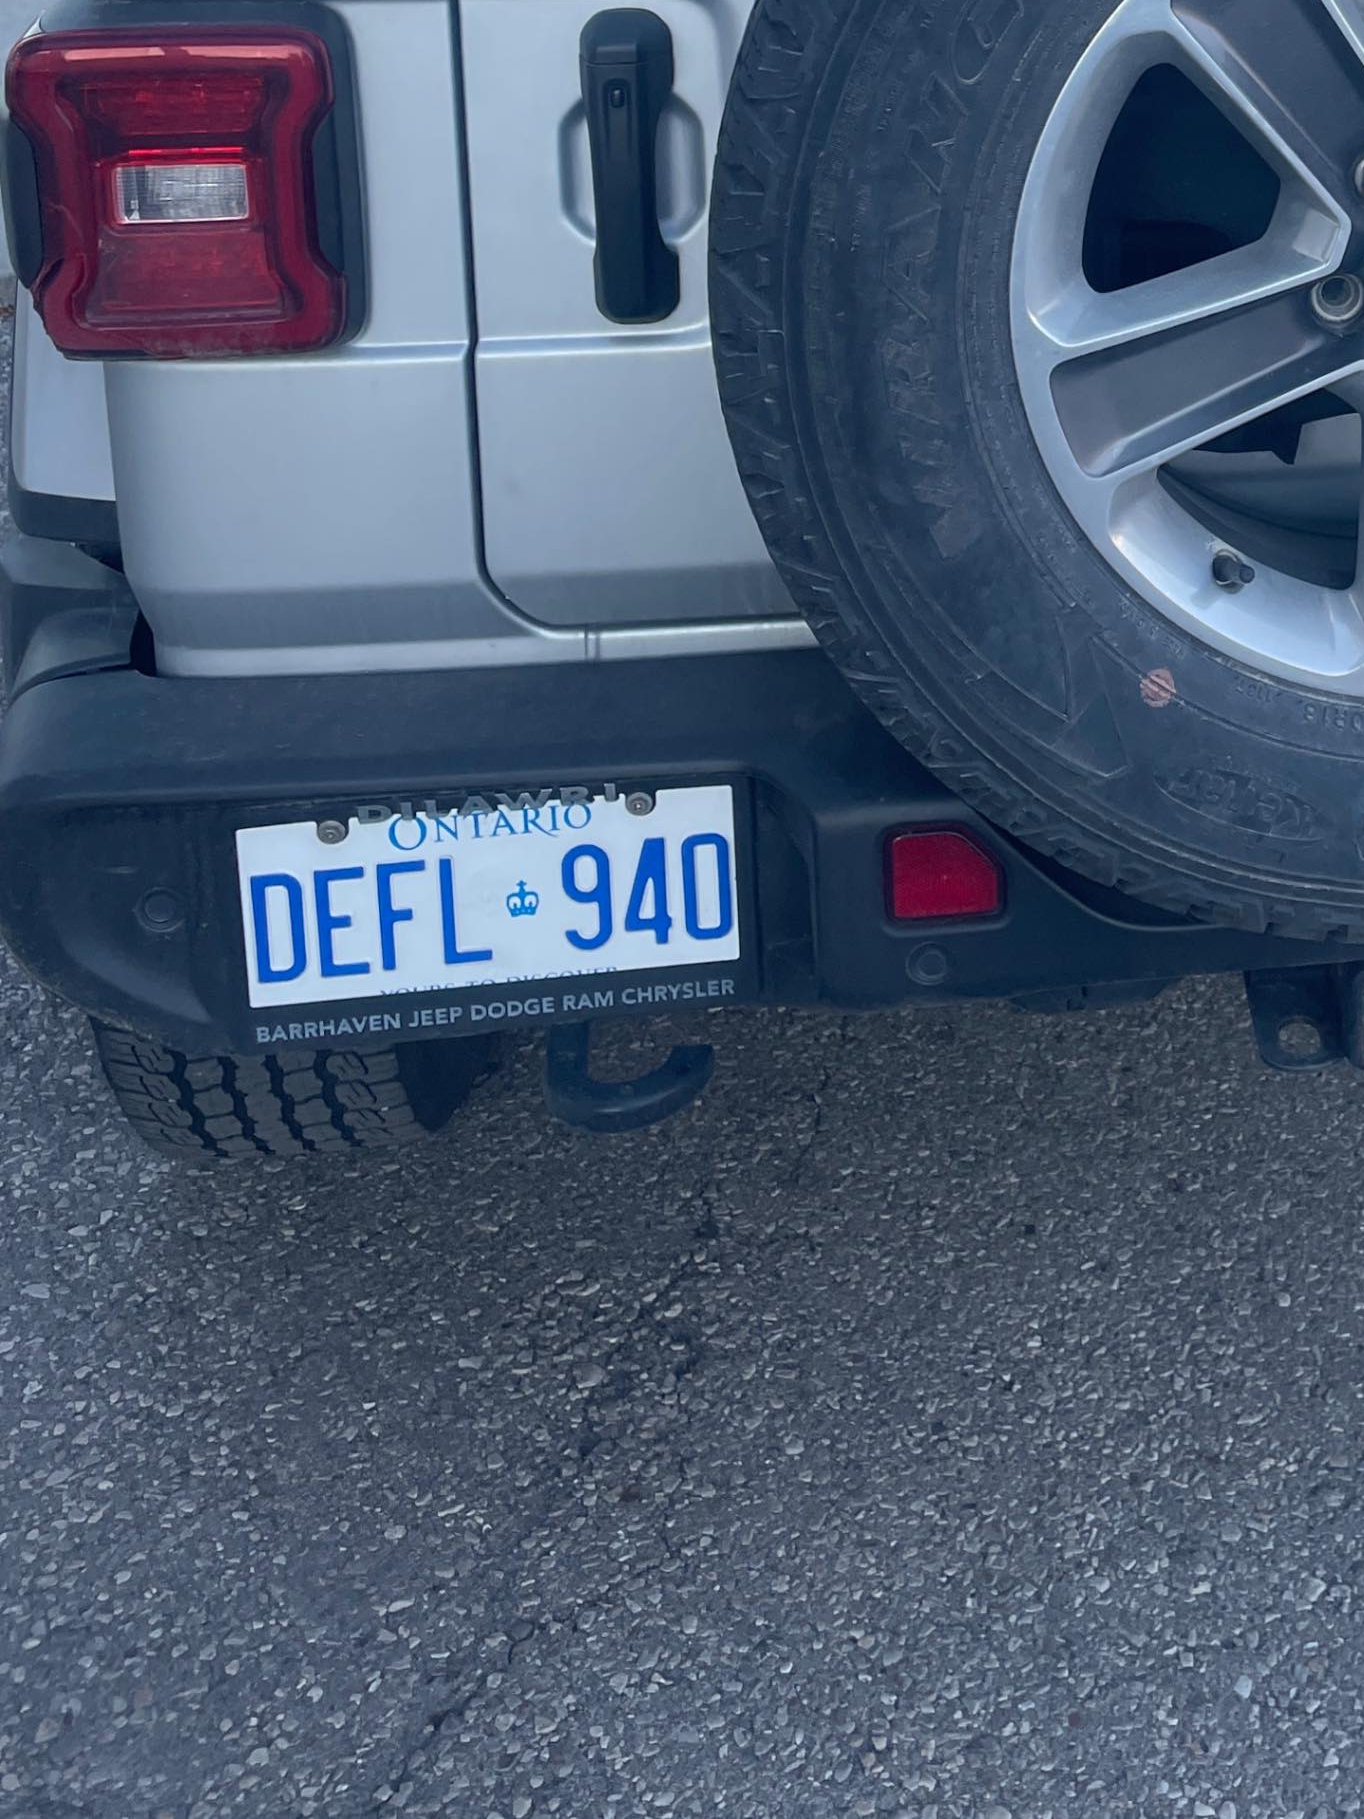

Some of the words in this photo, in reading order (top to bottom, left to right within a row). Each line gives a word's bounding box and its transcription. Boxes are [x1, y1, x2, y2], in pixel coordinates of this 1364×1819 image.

[355, 783, 617, 824] DILAWRI
[388, 803, 592, 850] ONTARIO
[250, 856, 493, 983] DEFL
[561, 831, 732, 951] 940
[256, 1012, 401, 1043] BARRHAVEN
[408, 1006, 463, 1028] JEEP
[470, 997, 555, 1021] DODGE
[563, 990, 614, 1012] RAM
[622, 979, 735, 1006] CHRYSLER
